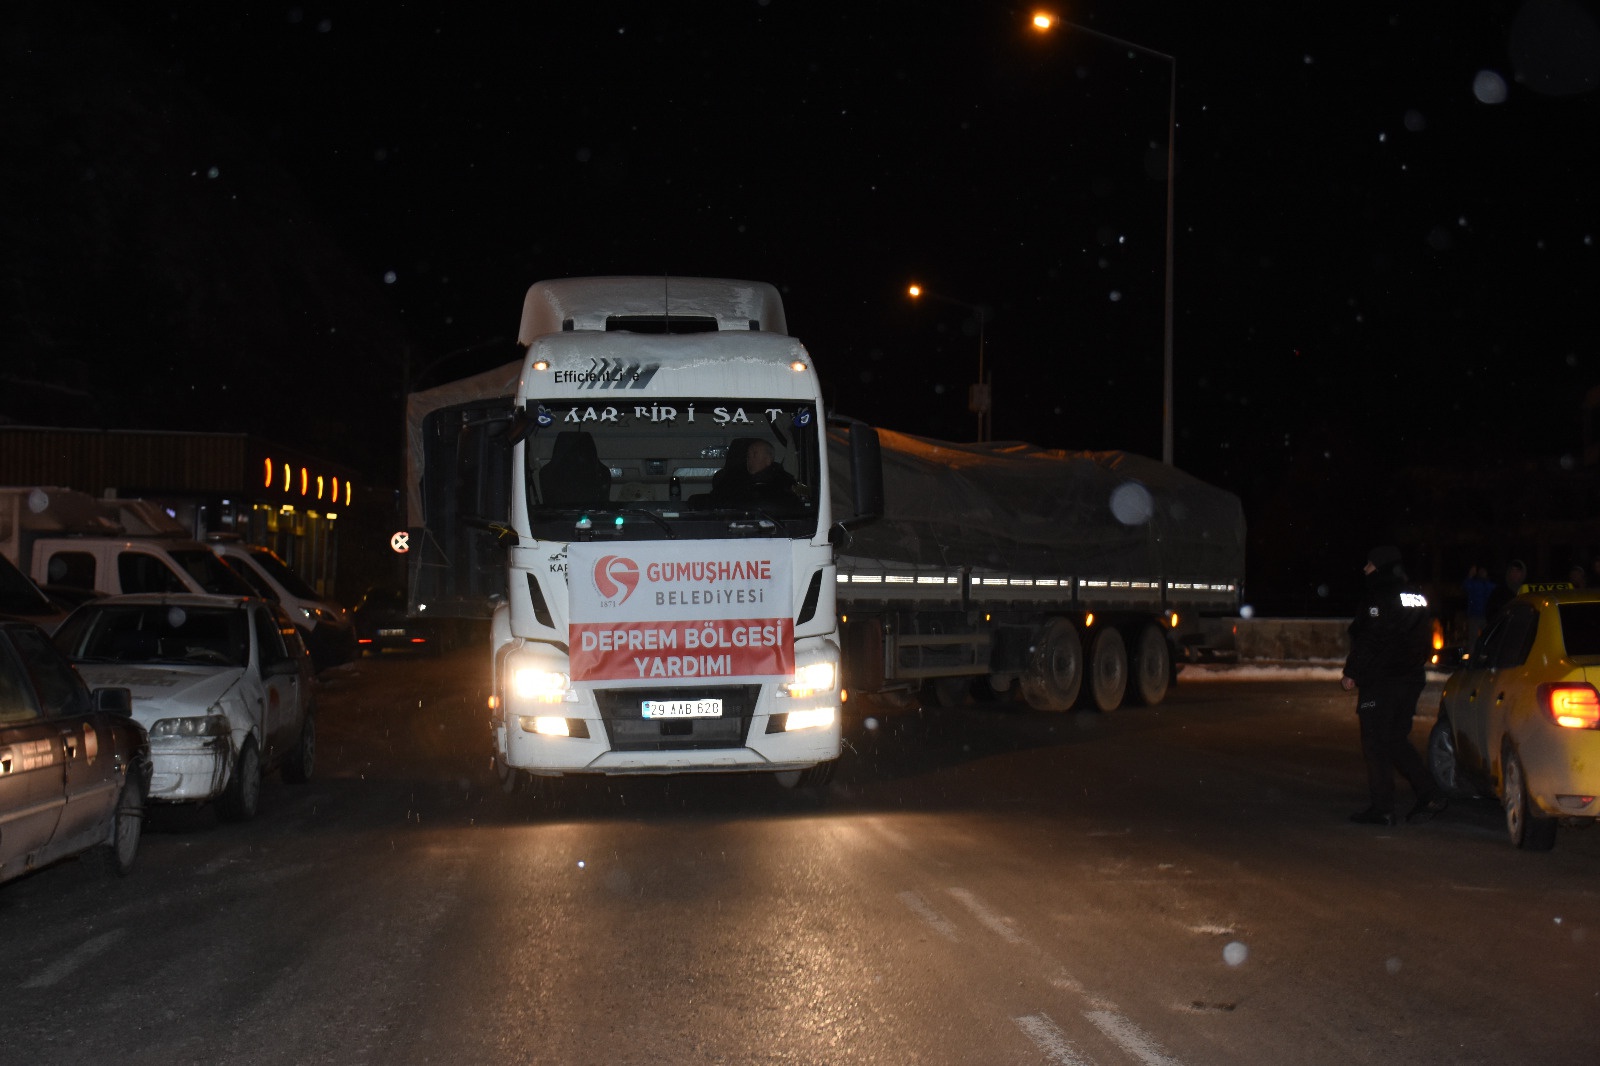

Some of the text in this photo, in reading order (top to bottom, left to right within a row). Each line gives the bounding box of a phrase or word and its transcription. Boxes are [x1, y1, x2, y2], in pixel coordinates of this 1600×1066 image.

[647, 560, 772, 584] GÜMÜŞHANE
[600, 600, 616, 608] 1871
[655, 589, 764, 606] BELEDİYESİ
[581, 620, 782, 652] DEPREM BÖLGESİ
[633, 654, 732, 677] YARDIMI
[651, 704, 665, 716] 29
[697, 702, 719, 714] 620
